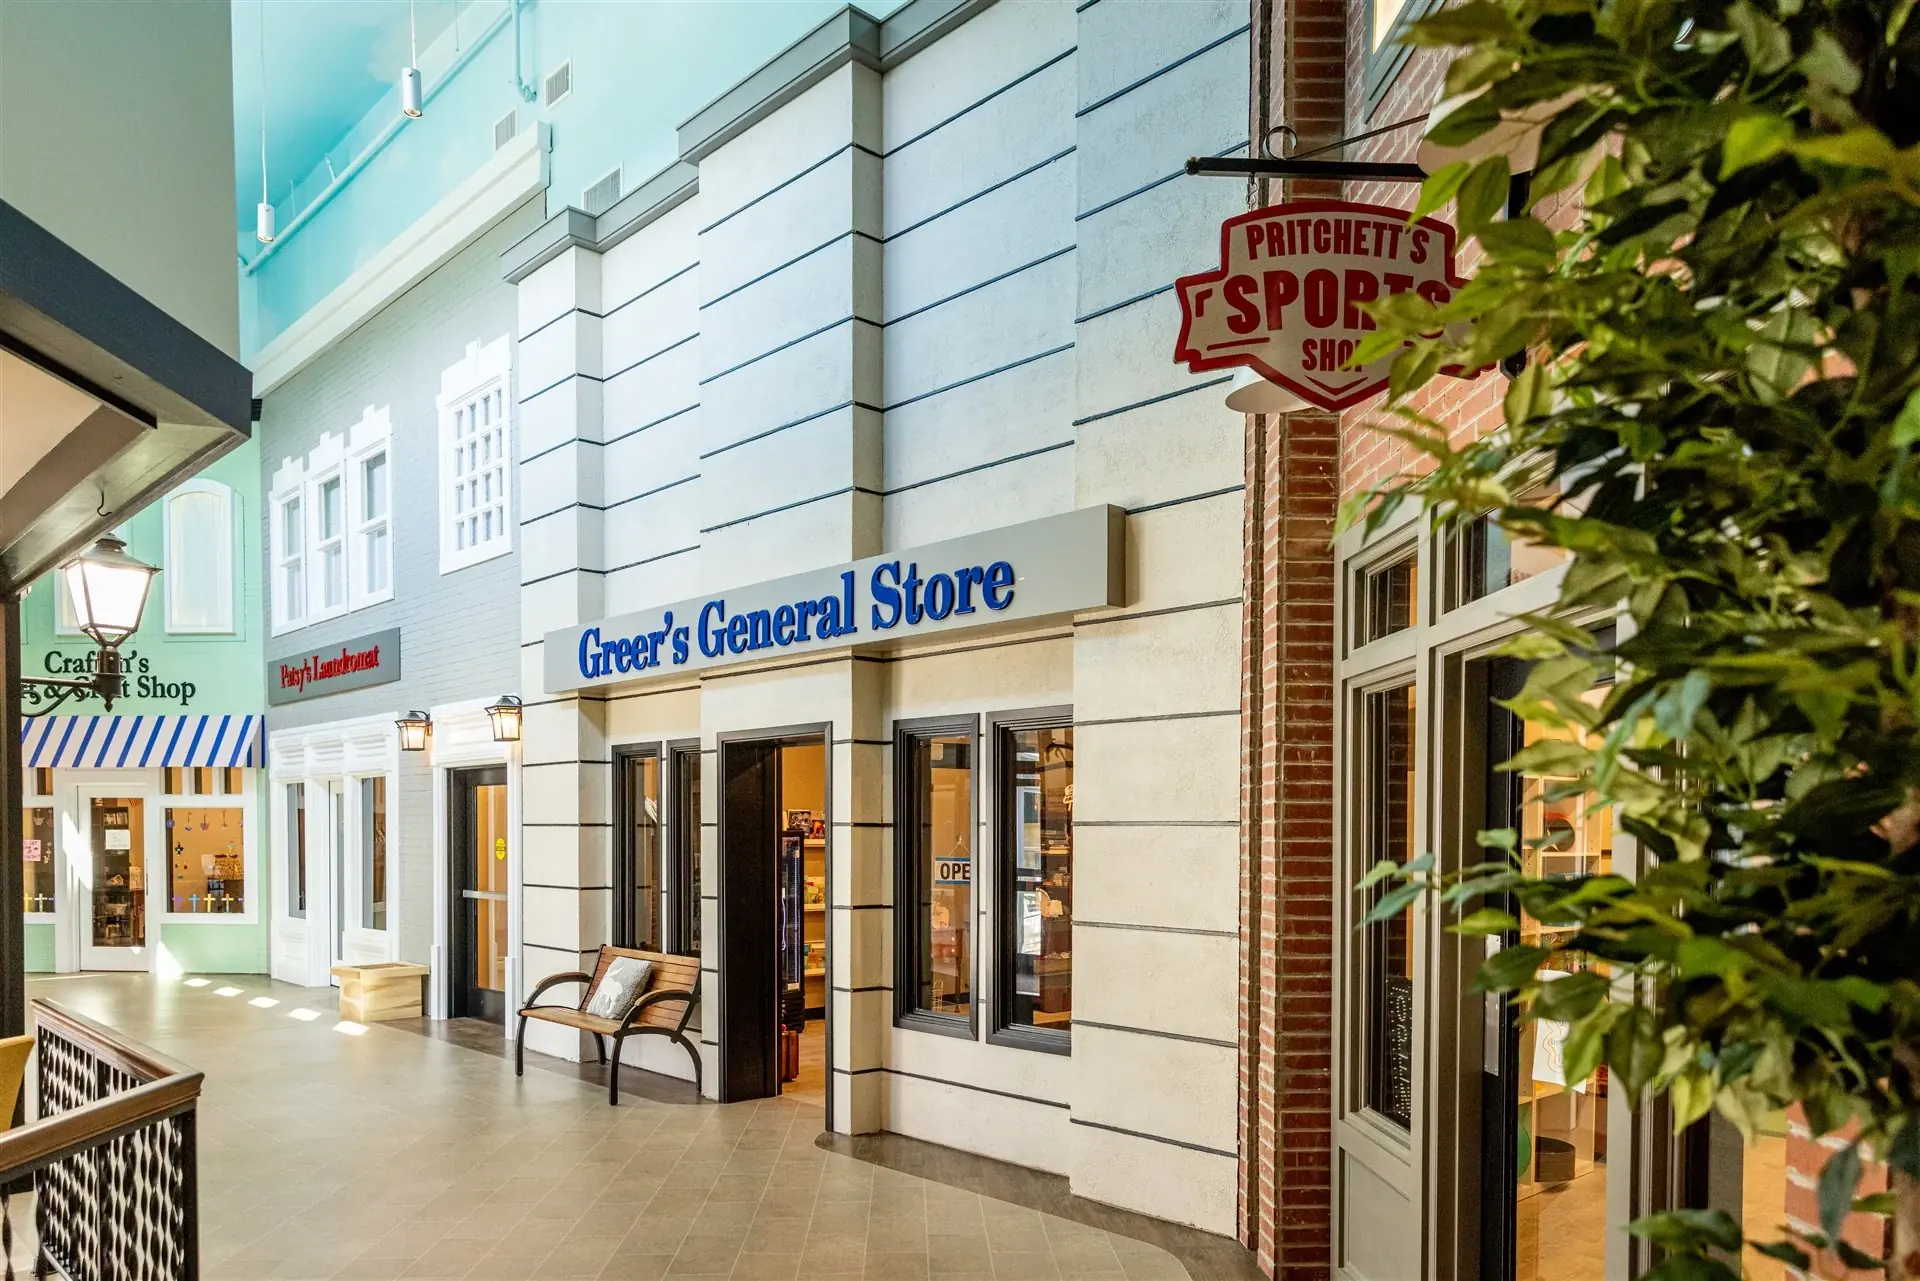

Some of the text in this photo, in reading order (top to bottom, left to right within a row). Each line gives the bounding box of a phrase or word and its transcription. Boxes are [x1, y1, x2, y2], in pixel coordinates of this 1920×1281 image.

[1246, 219, 1430, 264] PRITCHETT'S
[578, 560, 1015, 679] Greer's General Store
[44, 650, 150, 673] Crafn's
[280, 645, 379, 692] Patsy's Laundromat
[137, 675, 196, 705] Shop
[940, 862, 970, 880] OPE
